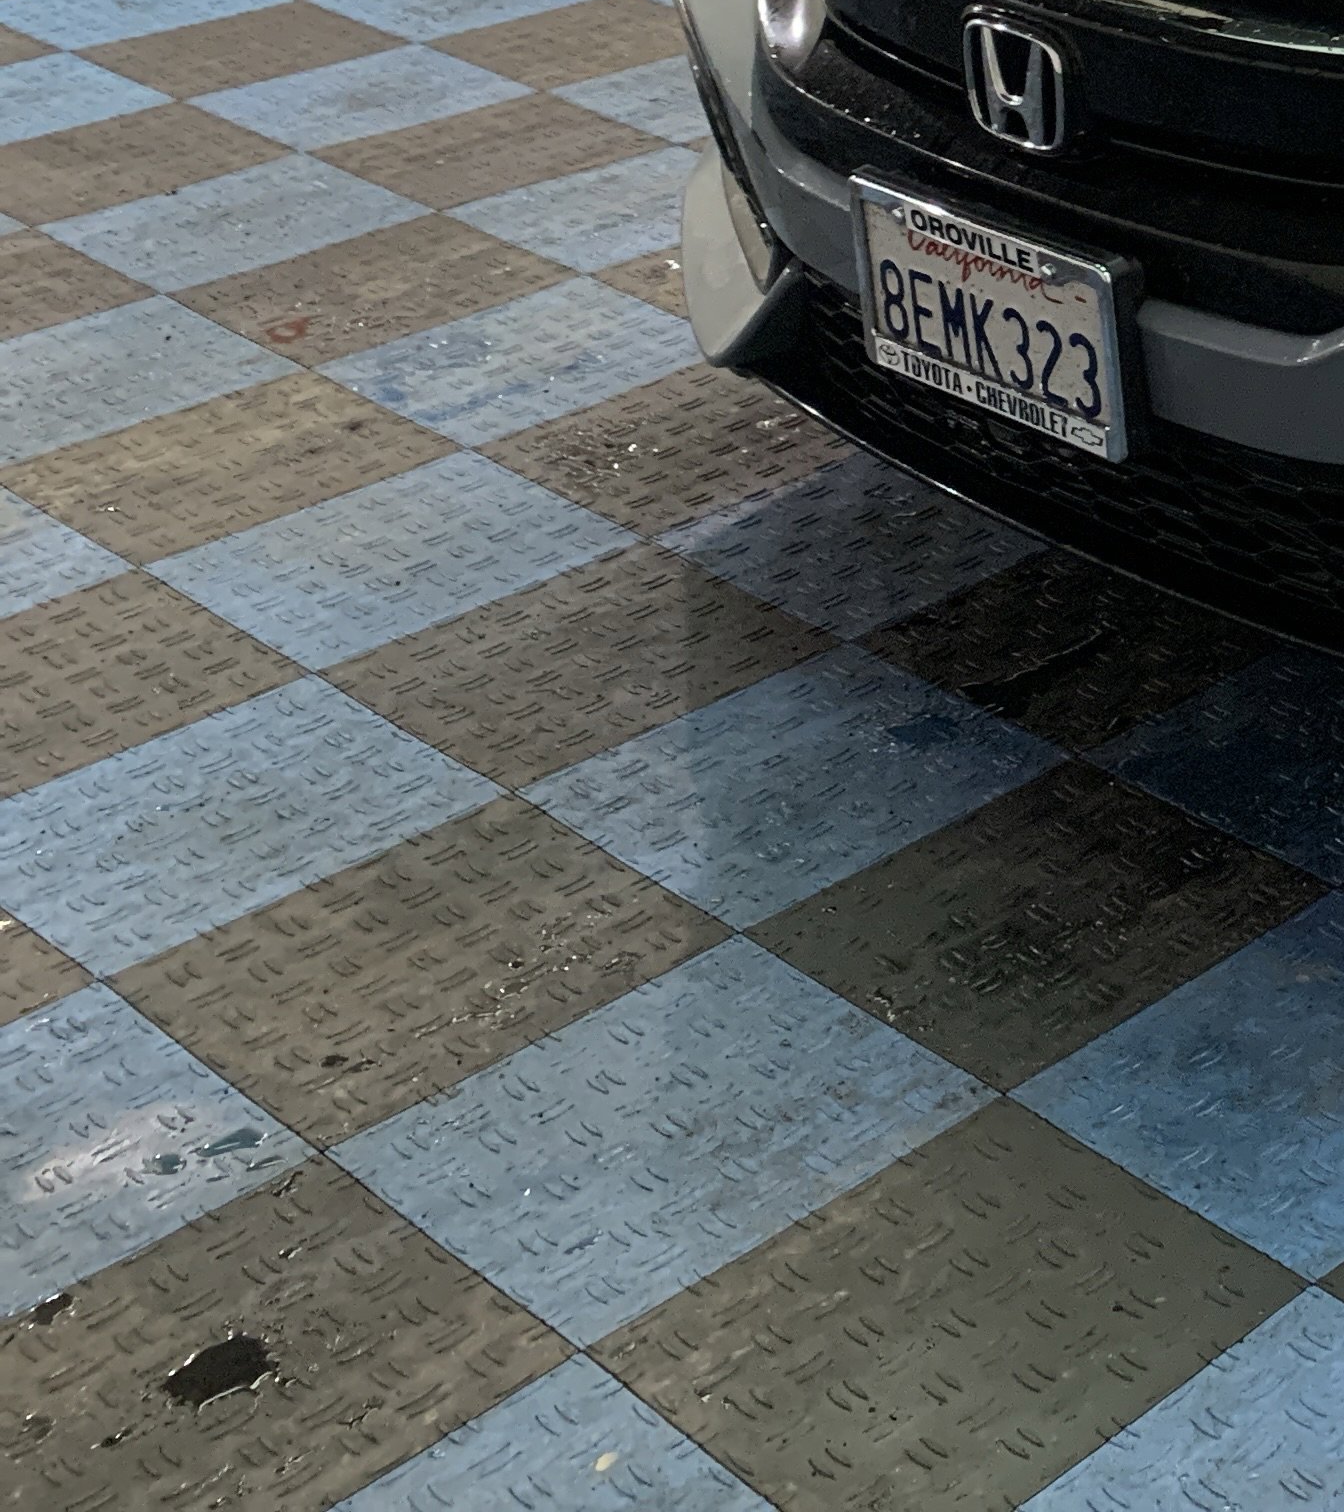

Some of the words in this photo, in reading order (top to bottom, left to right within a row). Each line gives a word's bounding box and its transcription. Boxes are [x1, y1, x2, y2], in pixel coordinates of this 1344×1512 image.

[911, 209, 1035, 272] OROVILLE
[879, 259, 1102, 419] 8EMK323
[899, 351, 965, 396] TOYOTA
[975, 381, 1070, 437] CHEVROLET
